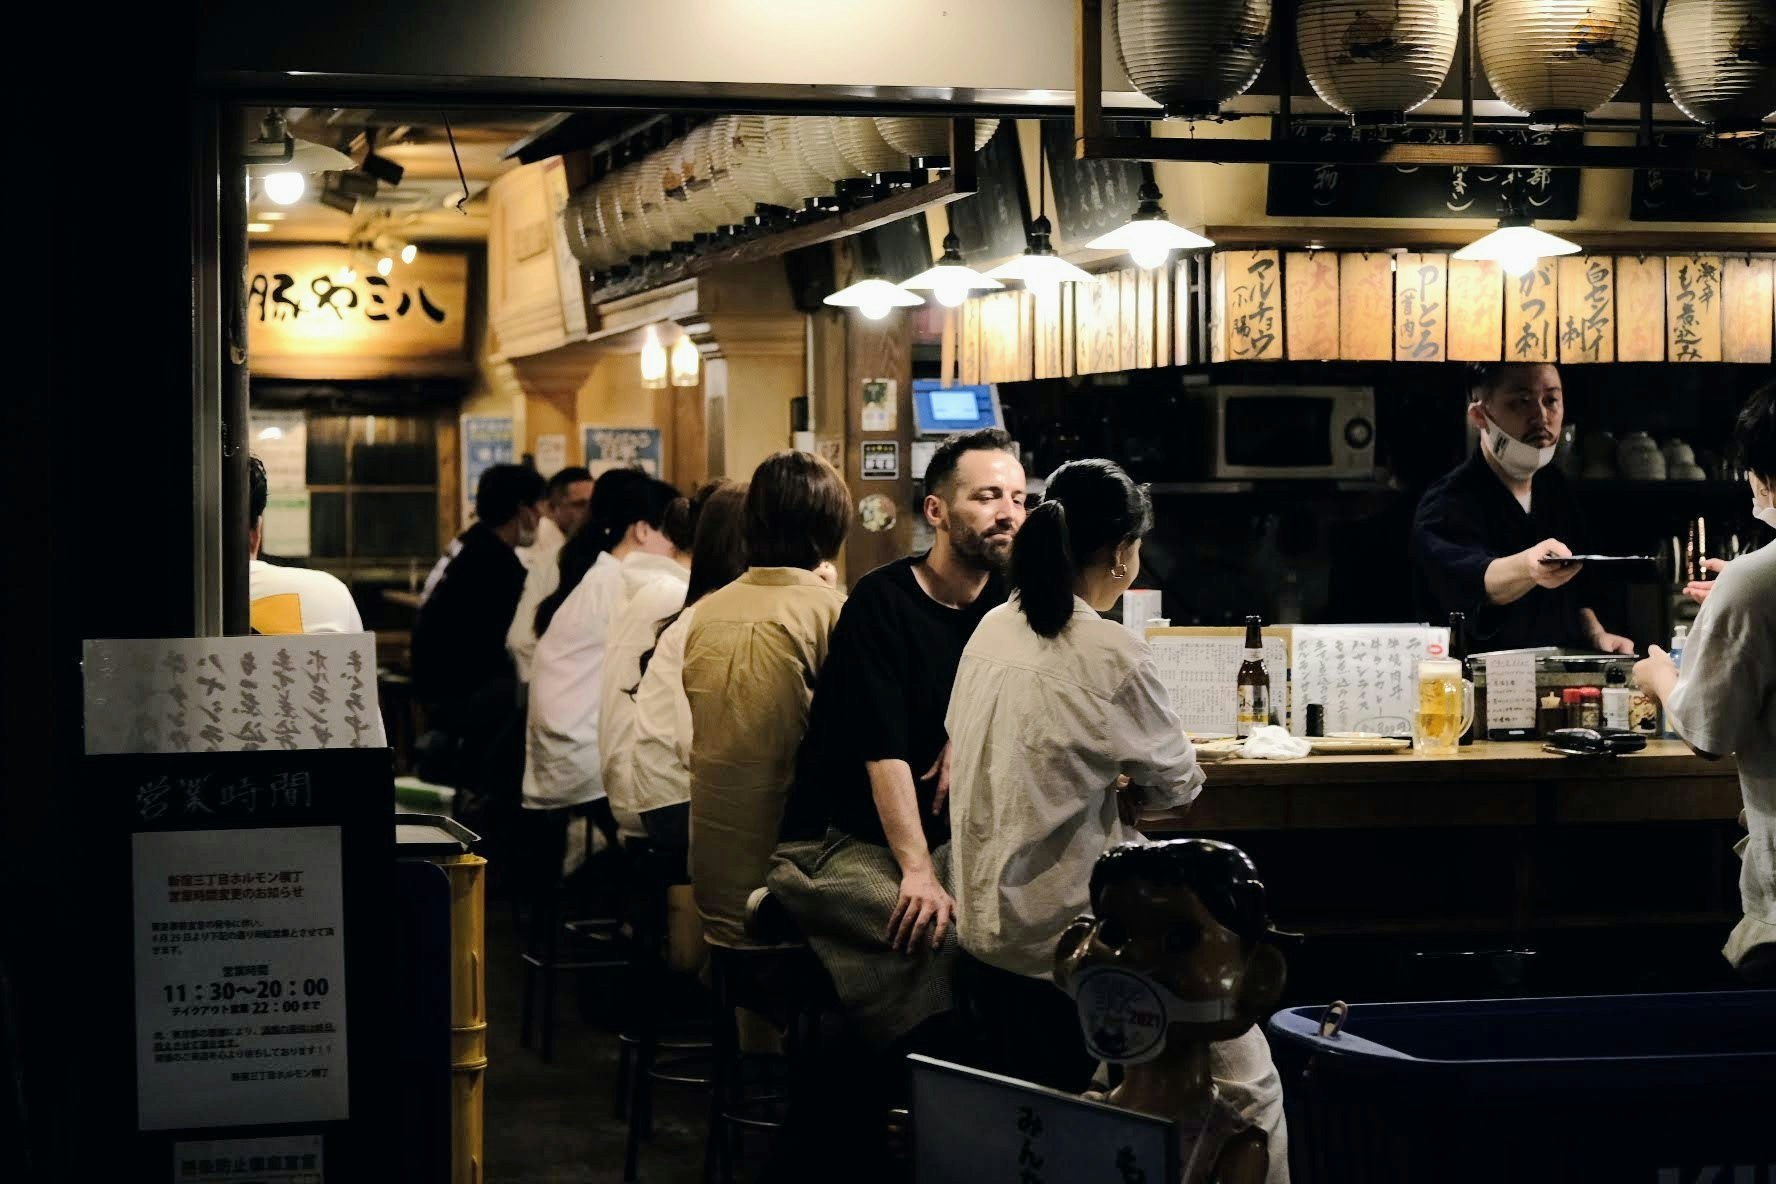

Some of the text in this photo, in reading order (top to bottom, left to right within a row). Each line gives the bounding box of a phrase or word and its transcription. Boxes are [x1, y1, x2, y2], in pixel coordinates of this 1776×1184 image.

[1248, 258, 1275, 357] マルチョウ
[1515, 263, 1555, 360] がつ刺
[1674, 265, 1703, 361] もつ煮込み
[136, 769, 312, 824] 営業時間
[168, 871, 304, 887] 新宿三丁目ホルモン横丁
[168, 886, 305, 903] 営業時間変更のお知らせ
[222, 964, 269, 978] 営業時間
